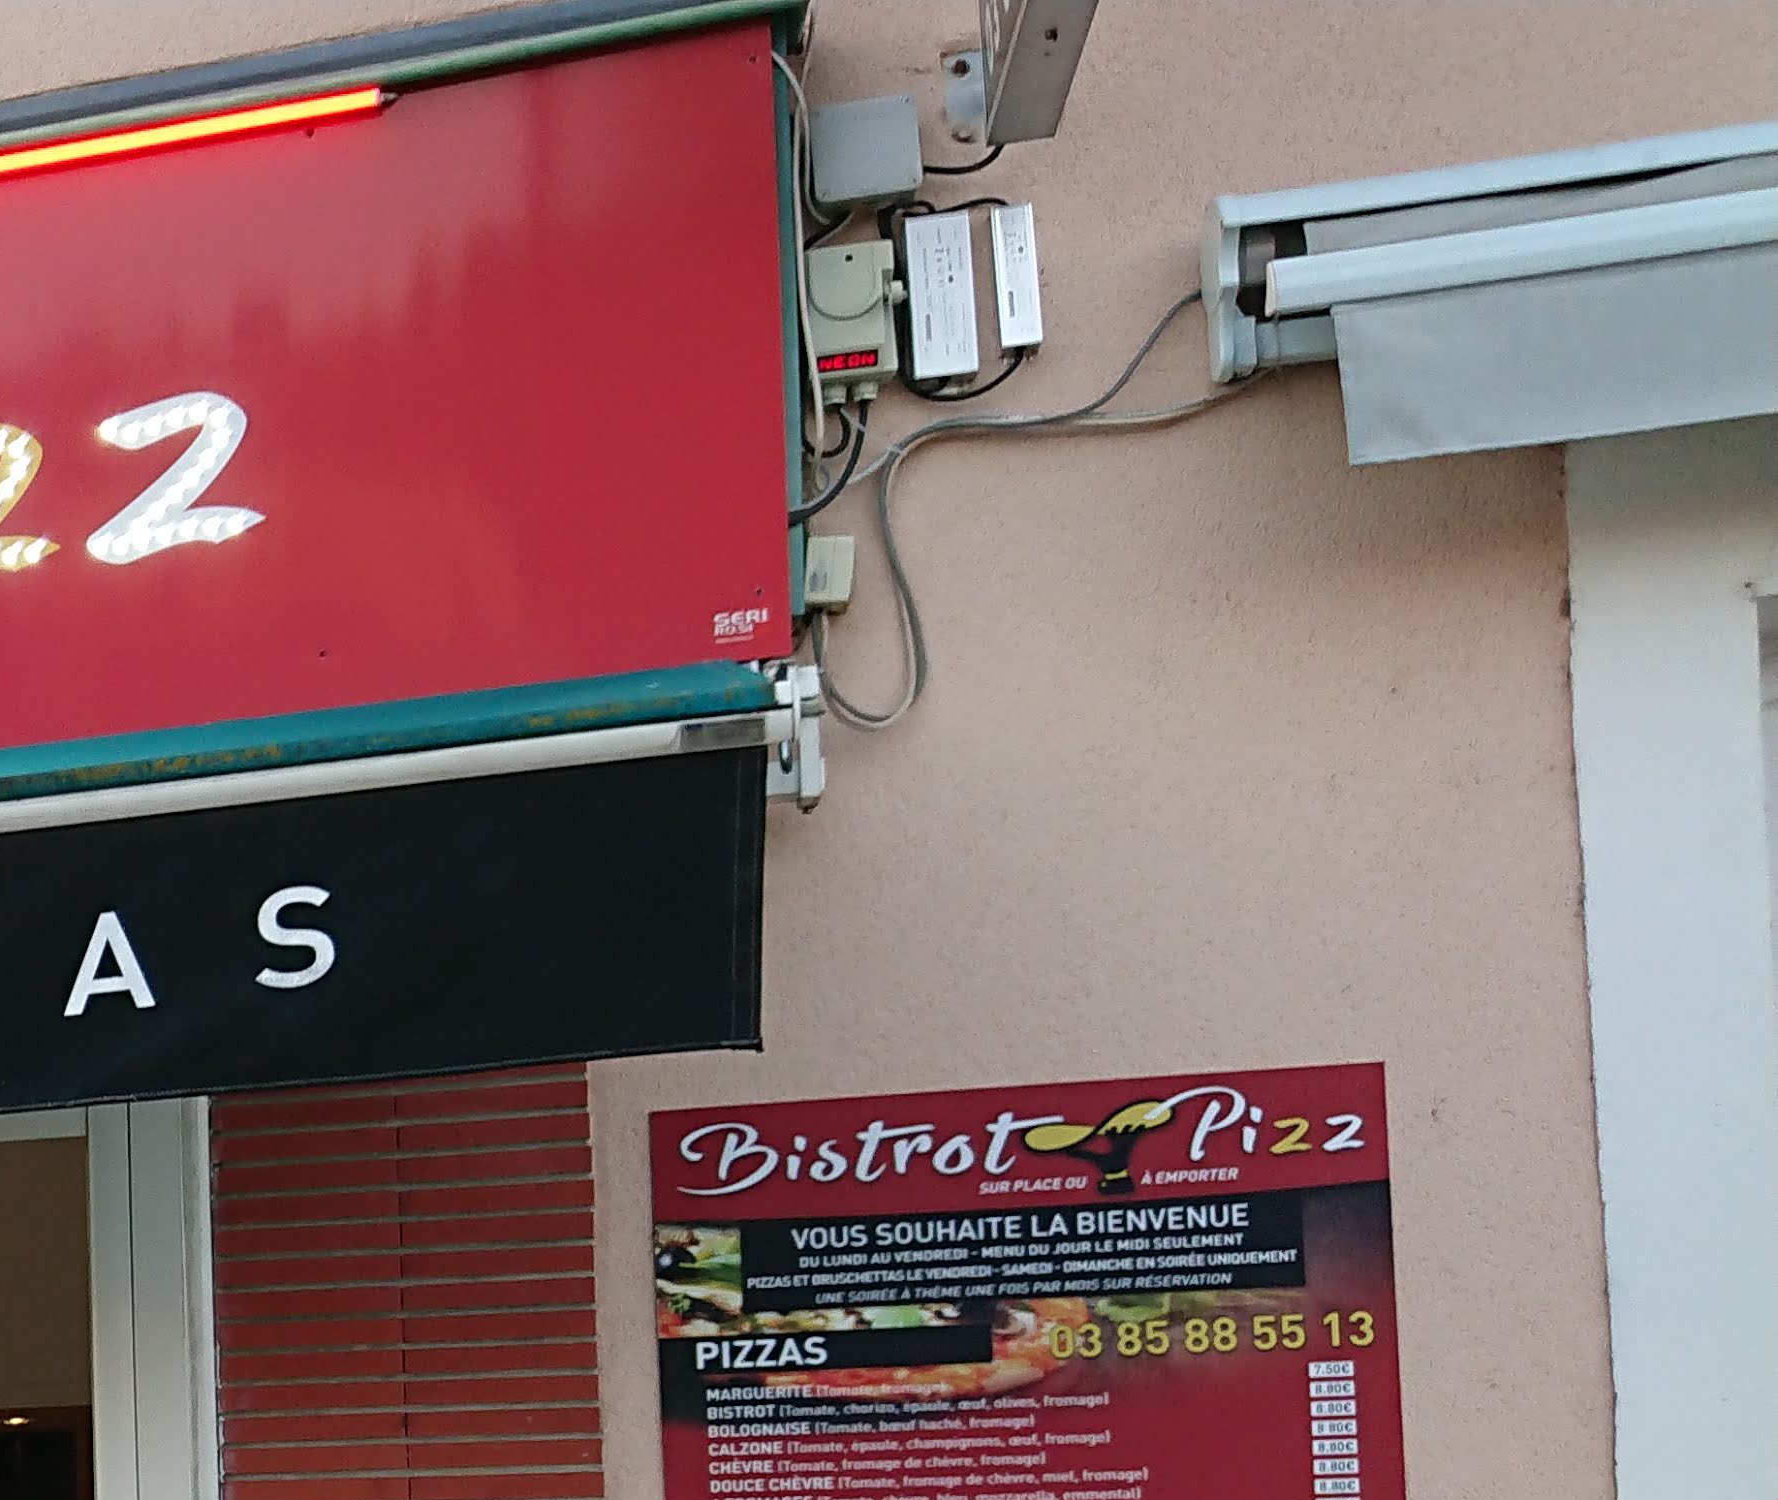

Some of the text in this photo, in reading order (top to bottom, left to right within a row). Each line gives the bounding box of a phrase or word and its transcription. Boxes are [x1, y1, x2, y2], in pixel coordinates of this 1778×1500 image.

[677, 1085, 1365, 1195] Bistrot Pizz
[978, 1181, 1010, 1195] SUR
[1013, 1177, 1062, 1193] PLACE
[1065, 1176, 1088, 1190] OU
[1153, 1167, 1239, 1184] EMPORTER
[791, 1202, 1249, 1250] VOUS SOUHAITE LA BIENVENUE
[799, 1233, 1243, 1268] DU LUNDI AU VENDREDI MENU DU JOUR LE MIDI SEULEMENT
[746, 1276, 791, 1290] PIZZAS
[793, 1275, 810, 1288] ET
[907, 1269, 924, 1282] LE
[926, 1266, 992, 1281] VENDREDI
[1002, 1262, 1053, 1277] SAMEDI
[1063, 1258, 1134, 1273] DIMANCHE
[1137, 1257, 1156, 1270] EN
[1157, 1252, 1205, 1268] SOIRÉE
[1207, 1249, 1298, 1267] UNIQUEMENT
[815, 1292, 845, 1305] UNE
[965, 1284, 995, 1298] UNE
[998, 1281, 1029, 1296] FOIS
[1032, 1281, 1062, 1295] PAR
[1102, 1277, 1132, 1291] SUR
[1048, 1310, 1376, 1359] 03 85 88 55 13
[695, 1336, 829, 1371] PIZZAS
[706, 1384, 813, 1402] MARGUERITE
[706, 1404, 776, 1421] BISTROT
[707, 1421, 812, 1438] BOLOGNAISE
[708, 1441, 784, 1457] CALZONE
[709, 1477, 764, 1493] DOUCE
